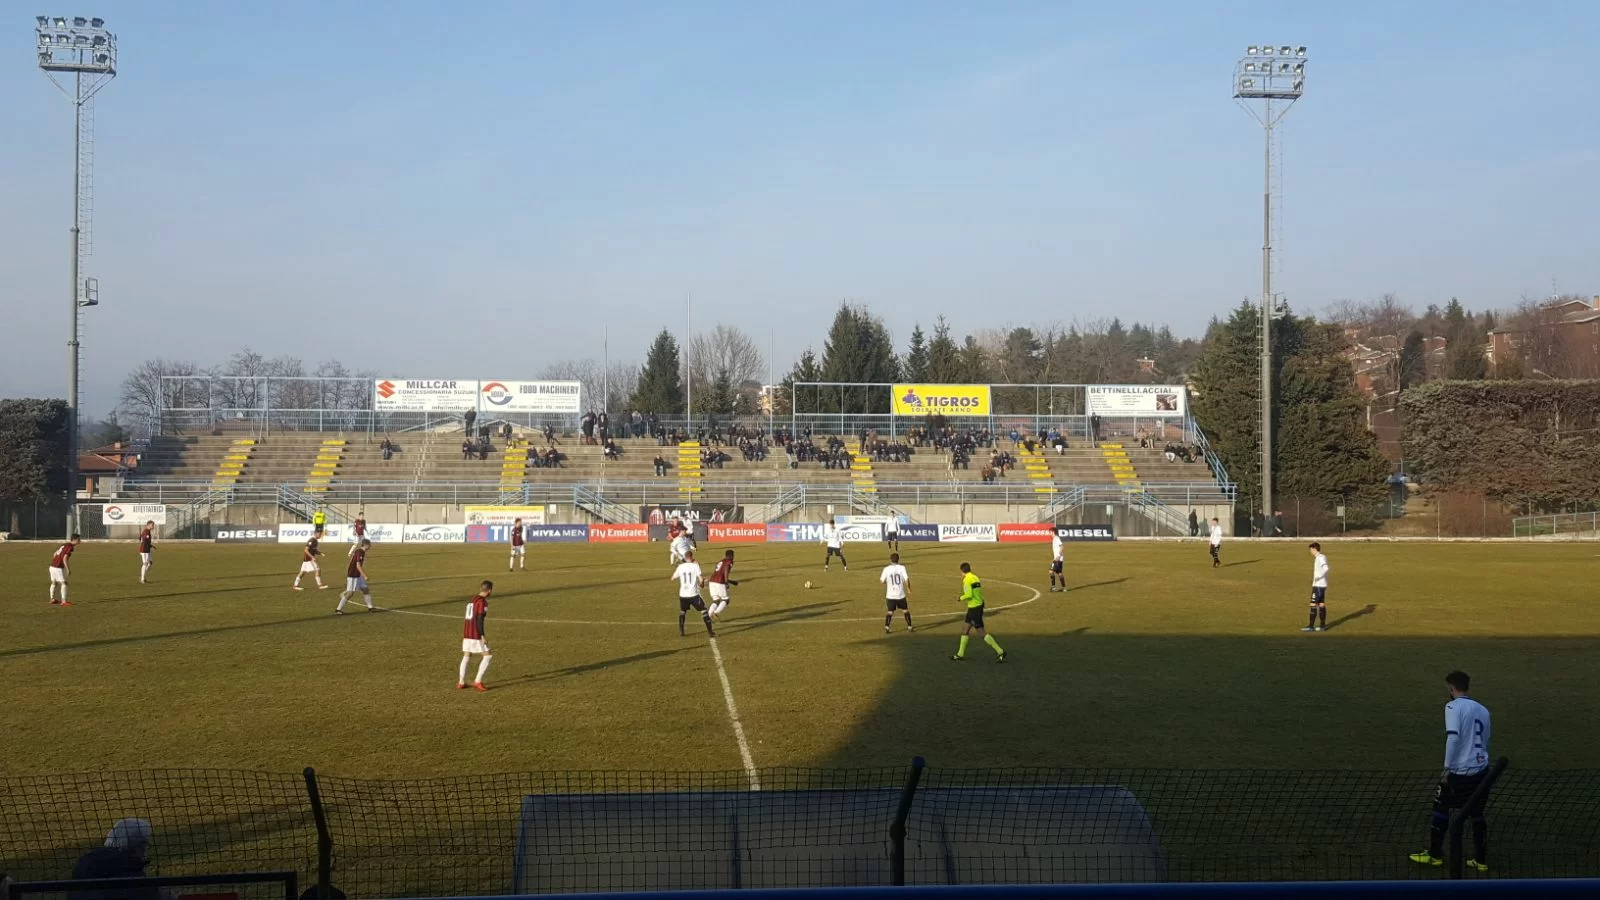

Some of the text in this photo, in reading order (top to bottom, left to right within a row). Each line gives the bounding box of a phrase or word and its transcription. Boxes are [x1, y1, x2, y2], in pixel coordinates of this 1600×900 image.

[406, 381, 457, 389] MILLCAR
[520, 385, 579, 394] FOOD MACHINERY
[926, 396, 979, 406] TIGROS
[665, 510, 700, 519] MILAN
[218, 530, 277, 538] DIESEL
[590, 528, 647, 538] Fly Emirates
[710, 528, 765, 538] Fly Emirates
[789, 525, 824, 540] TIM
[943, 526, 993, 535] PREMIUM
[1058, 529, 1112, 537] DIESEL
[444, 532, 464, 540] BPM
[683, 572, 692, 584] 11
[890, 574, 901, 586] 10
[1474, 718, 1484, 748] 3
